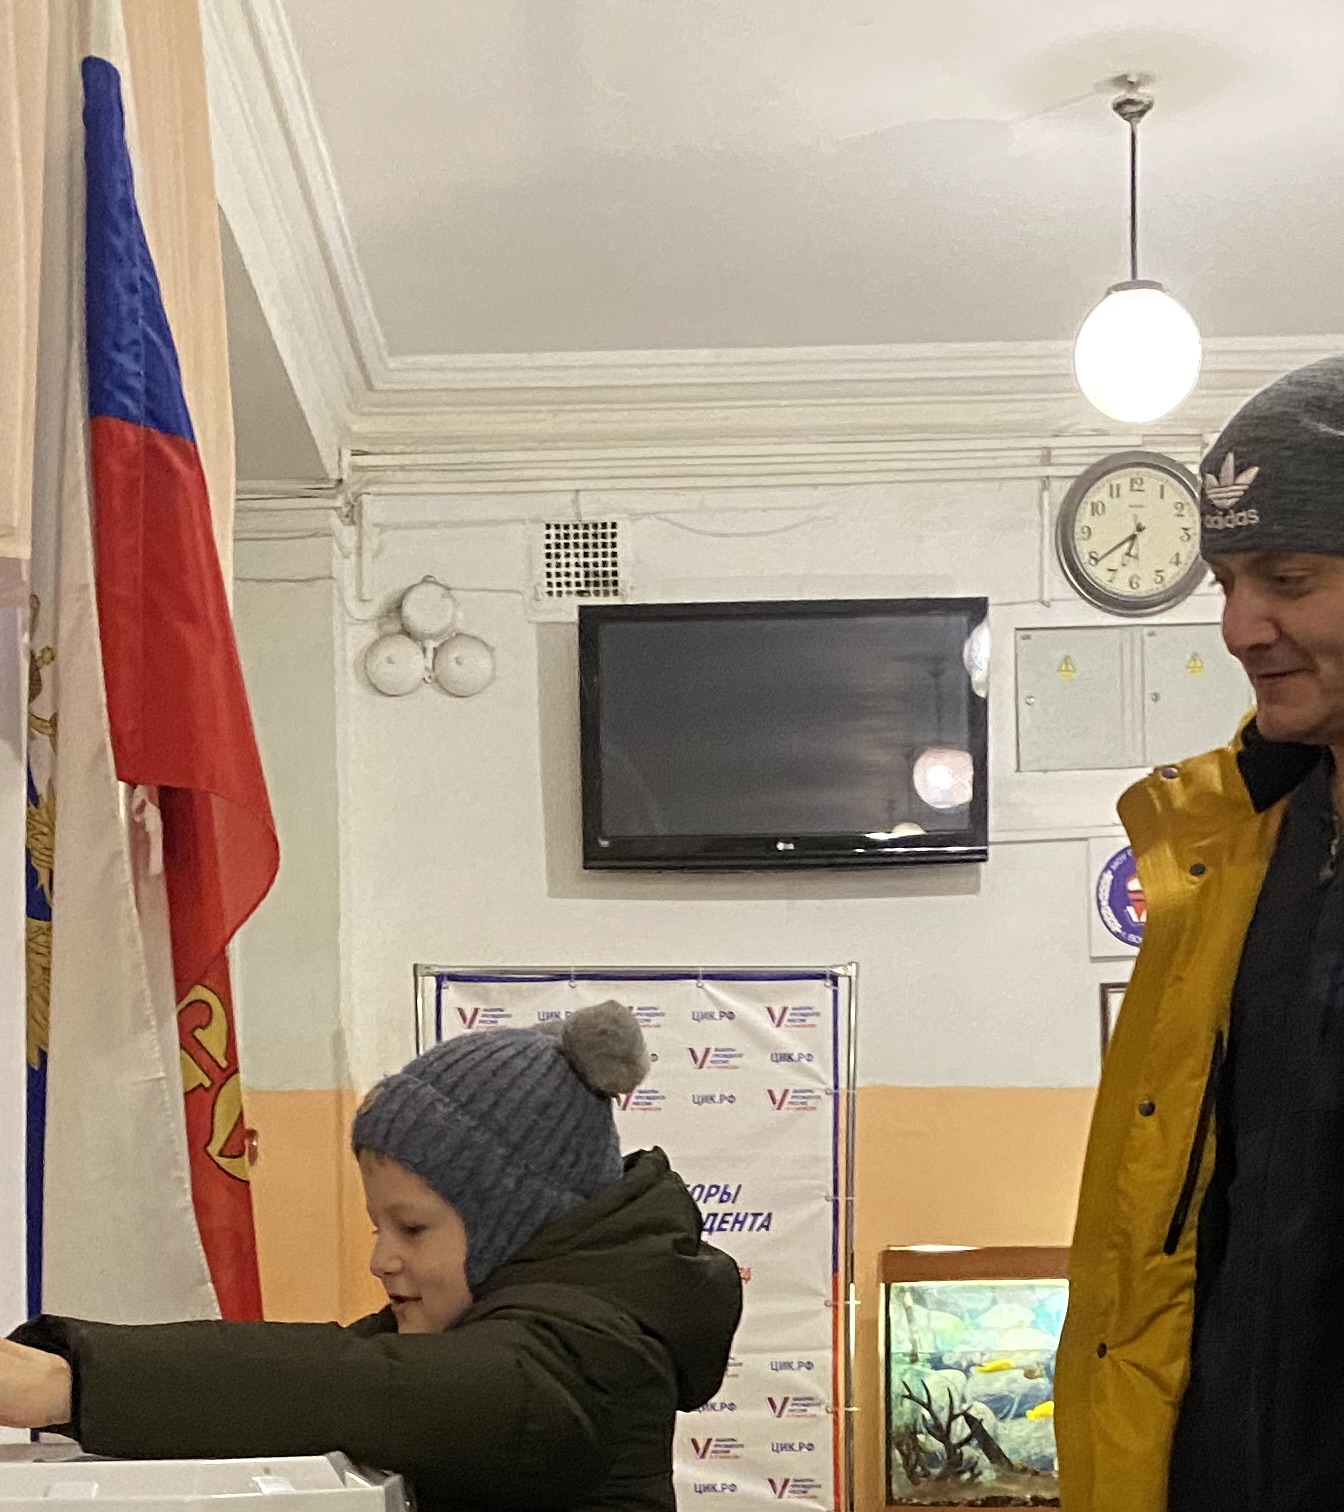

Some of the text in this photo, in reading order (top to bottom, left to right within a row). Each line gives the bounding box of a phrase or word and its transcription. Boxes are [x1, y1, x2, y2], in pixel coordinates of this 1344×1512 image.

[1109, 483, 1121, 499] 11
[1129, 477, 1145, 492] 12
[1159, 484, 1165, 499] 1
[1090, 500, 1105, 517] 10
[1174, 501, 1185, 517] 2
[1080, 525, 1092, 541] 9
[1179, 527, 1192, 542] 3
[1088, 551, 1099, 567] 8
[1169, 552, 1181, 567] 4
[1106, 568, 1118, 583] 7
[1129, 574, 1140, 590] 6
[1154, 569, 1164, 584] 5
[692, 1011, 736, 1022] ЦИК.РФ
[770, 1052, 814, 1063] ЦИК.РФ
[692, 1094, 736, 1105] ЦИК.РФ
[685, 1184, 742, 1204] ОРЫ
[771, 1361, 814, 1372] ЦИК.РФ
[771, 1442, 814, 1454] ЦИК.РФ
[694, 1483, 737, 1494] ЦИК.РФ
